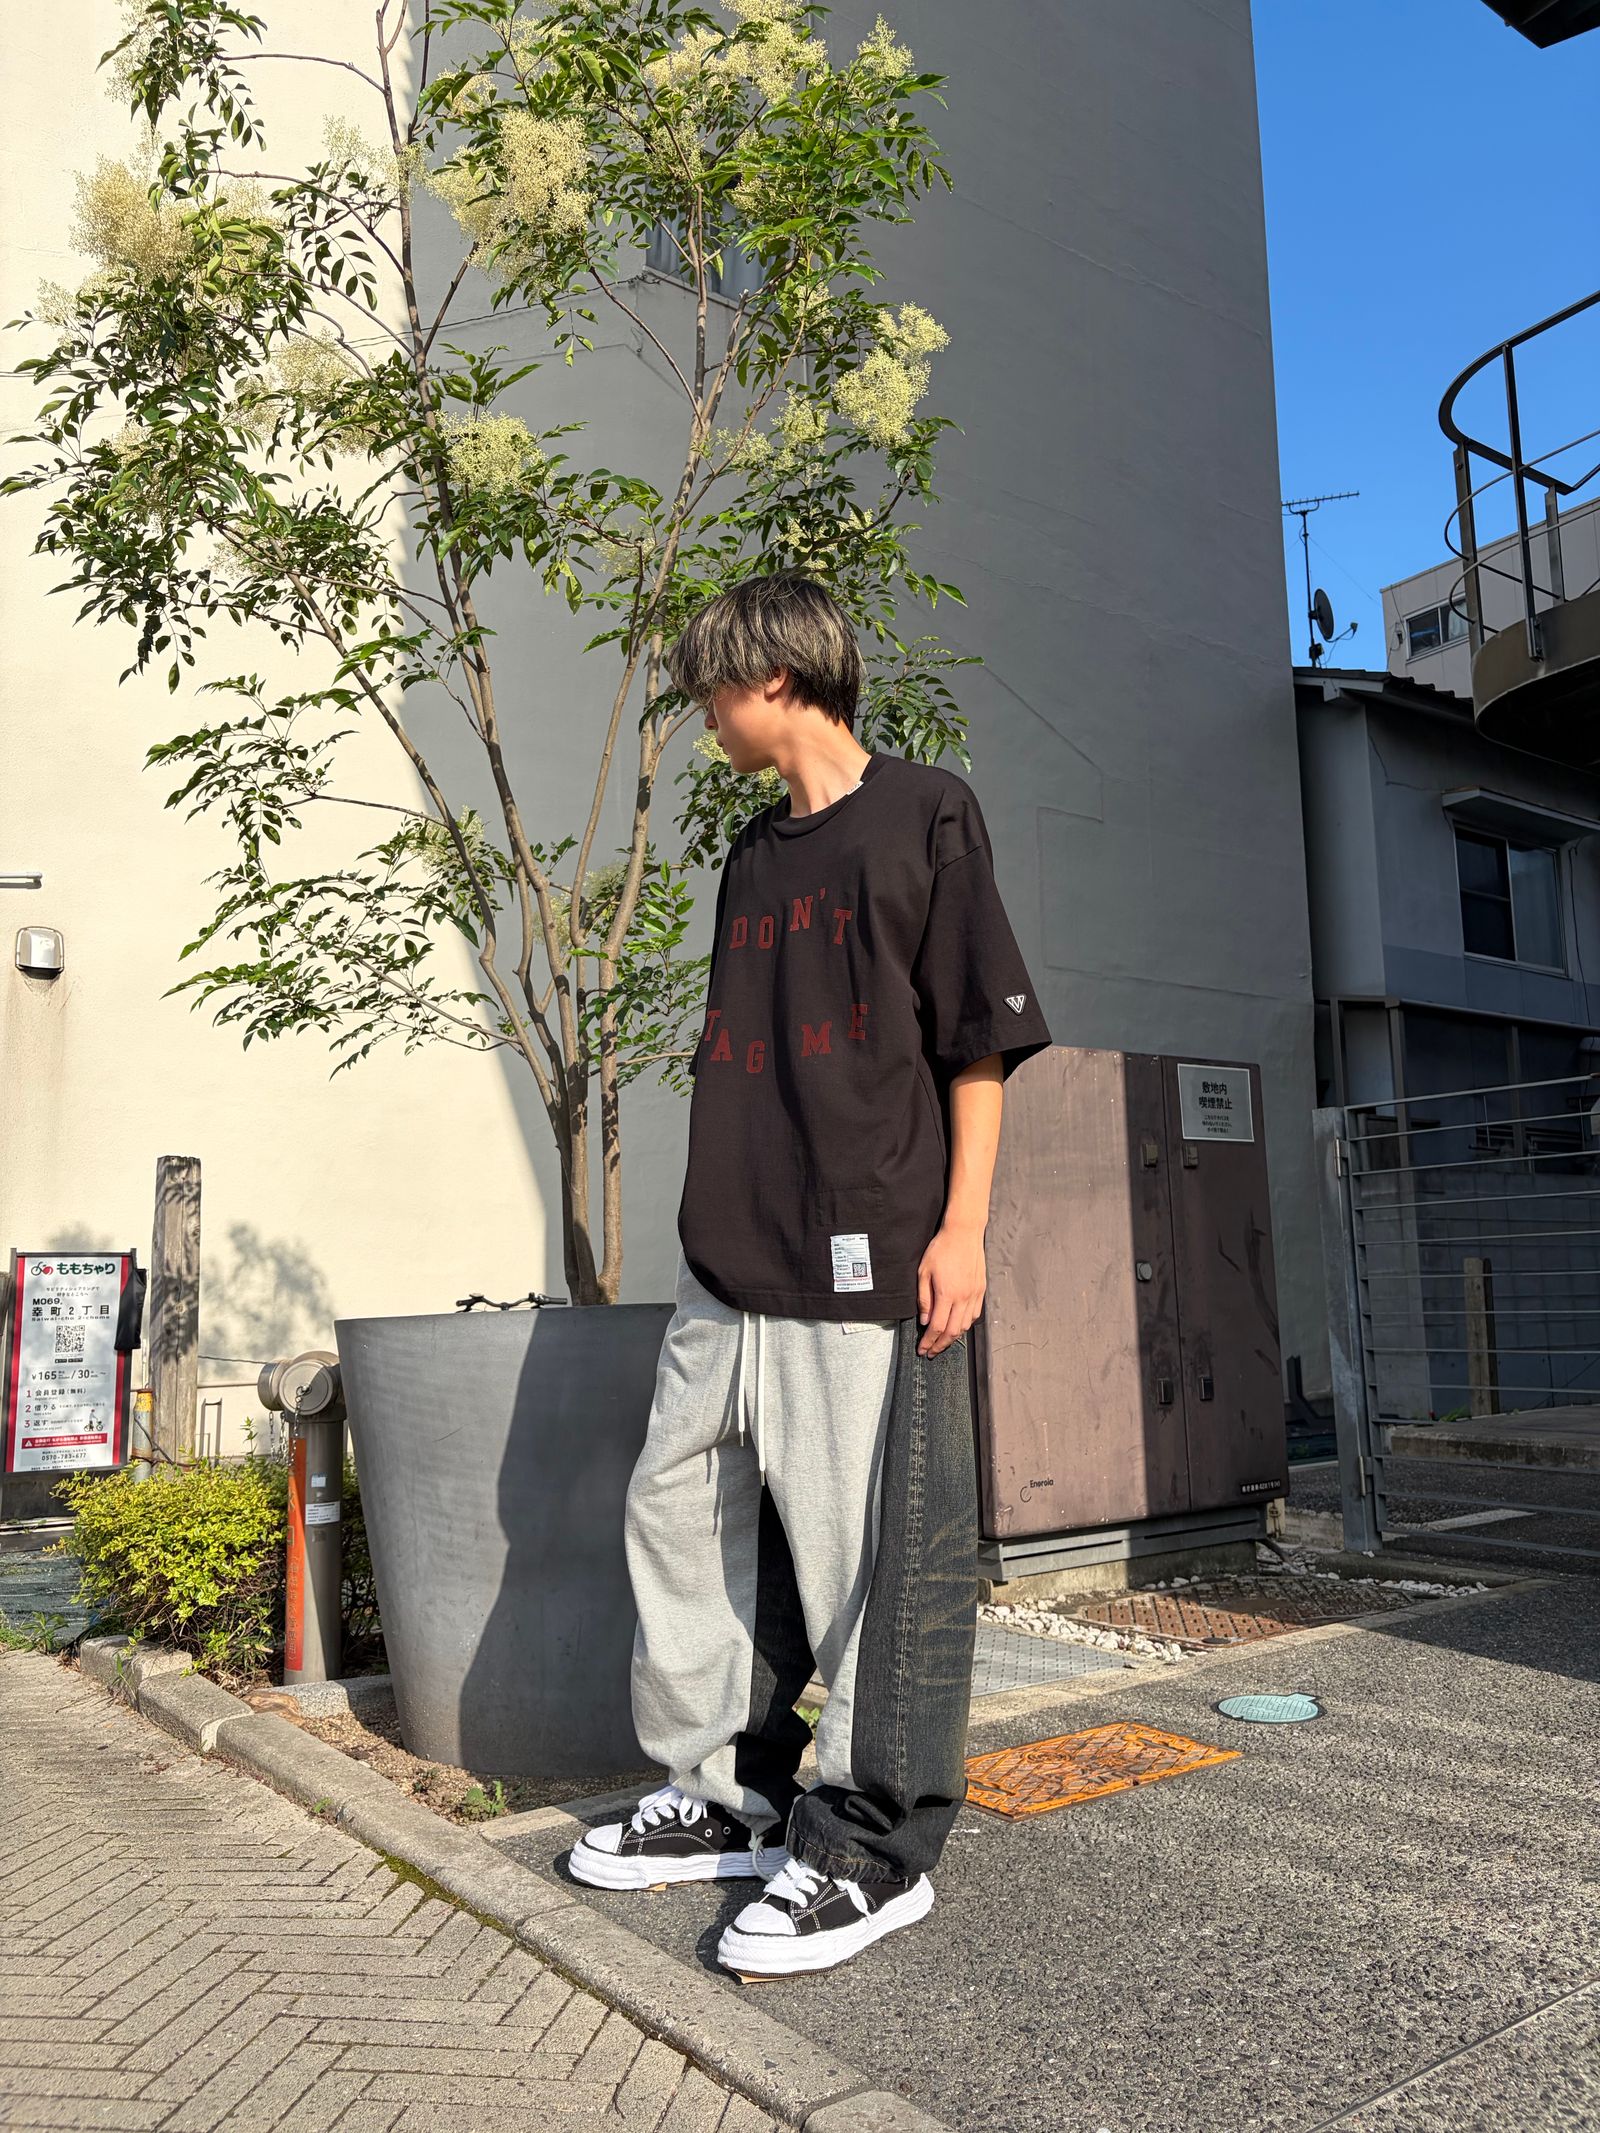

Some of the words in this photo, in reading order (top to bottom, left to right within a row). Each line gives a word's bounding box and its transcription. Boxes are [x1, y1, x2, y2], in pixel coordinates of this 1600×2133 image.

[729, 888, 853, 949] DON'T
[704, 1009, 766, 1074] TAG
[801, 1003, 869, 1057] ME
[1202, 1081, 1228, 1095] 敷地内
[1199, 1096, 1233, 1110] 喫煙禁止
[57, 1262, 115, 1275] ももちゃり
